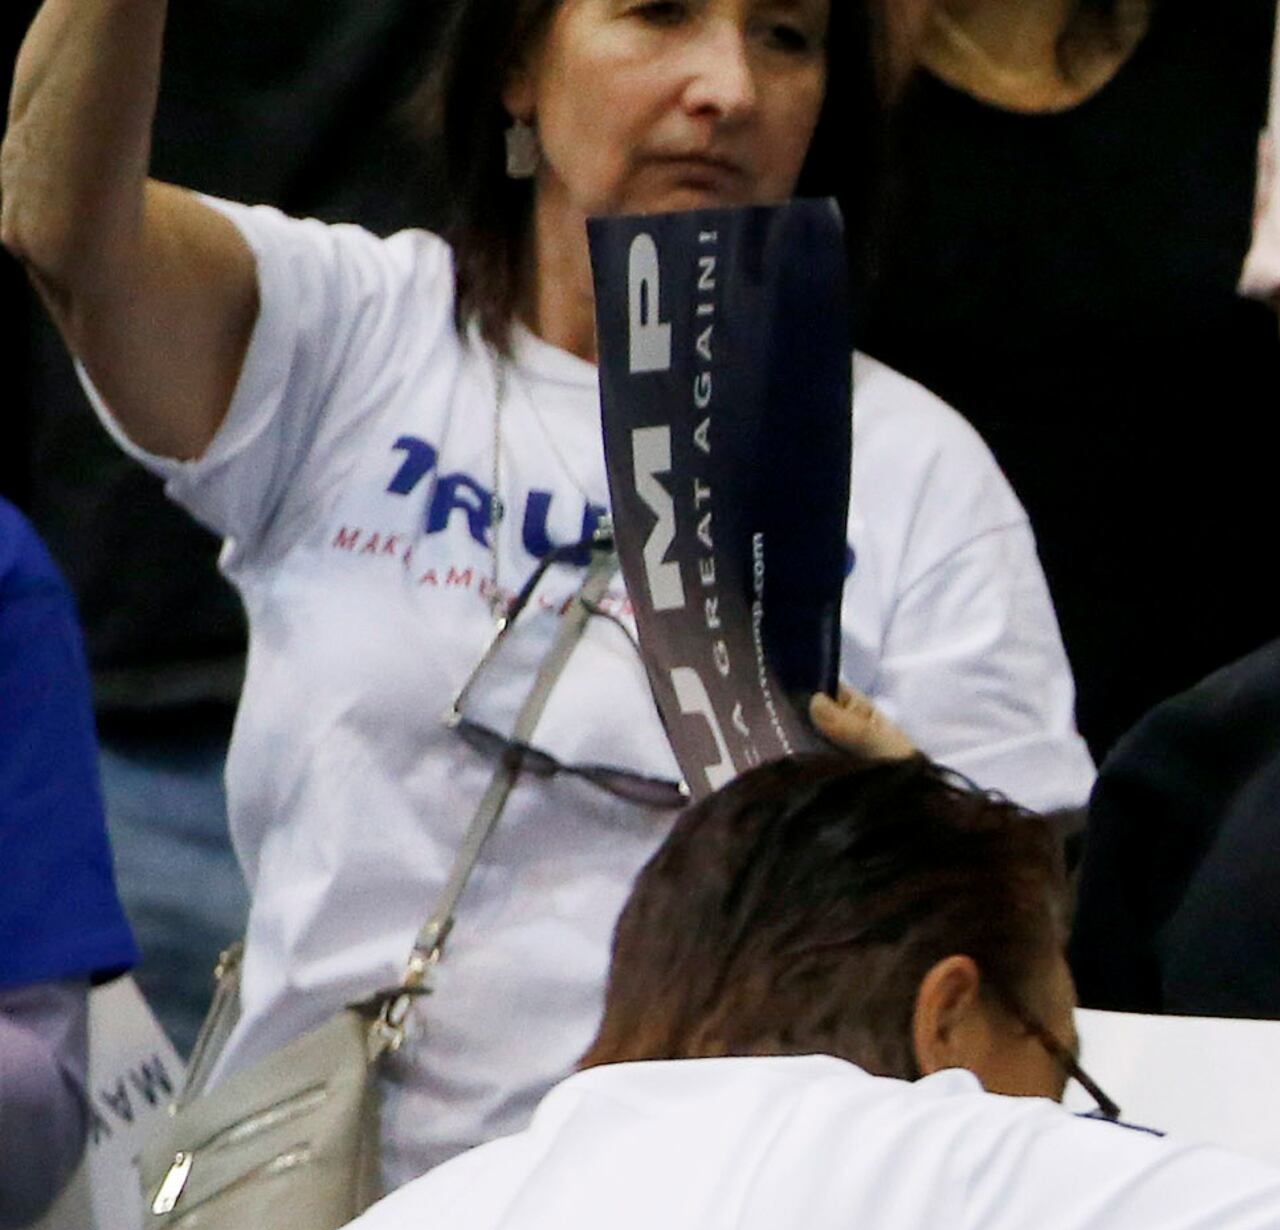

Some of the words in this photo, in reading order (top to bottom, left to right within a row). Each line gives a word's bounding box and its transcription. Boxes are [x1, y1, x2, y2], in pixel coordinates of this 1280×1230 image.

[693, 230, 719, 455] AGAIN!
[627, 231, 738, 792] UMP
[694, 477, 731, 678] GREAT
